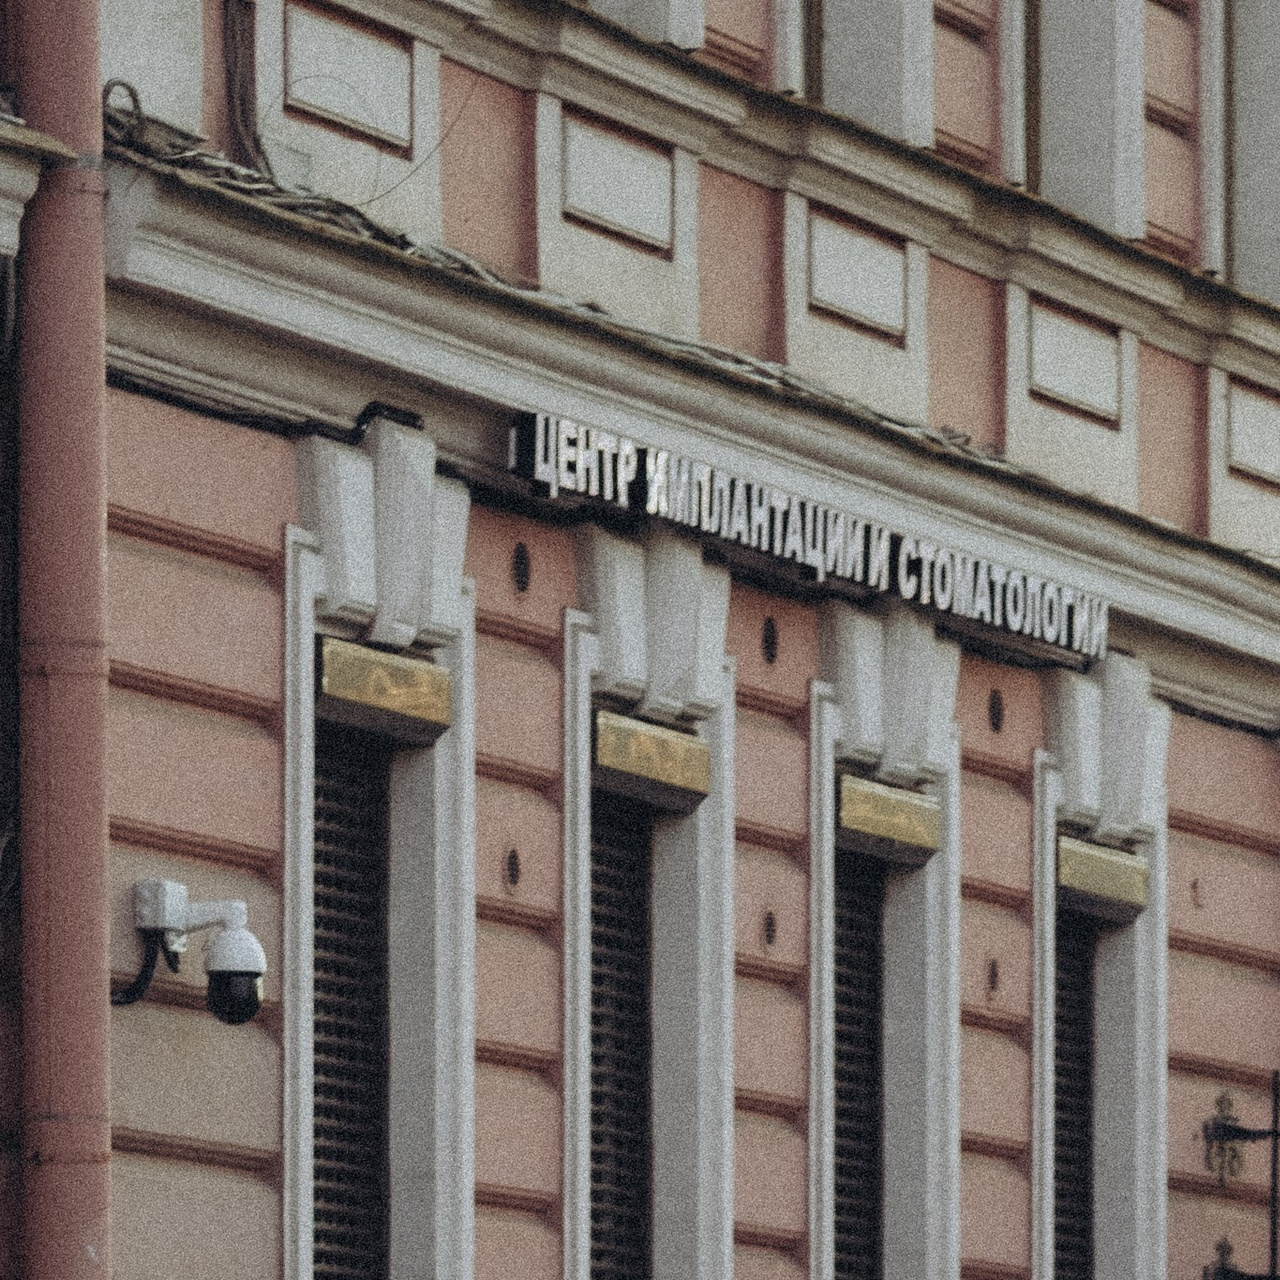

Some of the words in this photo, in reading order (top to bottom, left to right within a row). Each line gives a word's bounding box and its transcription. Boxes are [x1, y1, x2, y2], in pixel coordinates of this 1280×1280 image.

[534, 411, 638, 508] ЦЕНТР
[646, 447, 864, 583] ИМПЛАНТАЦИИ
[868, 524, 889, 592] И
[898, 535, 1109, 661] СТОМАТОЛОГИИ
